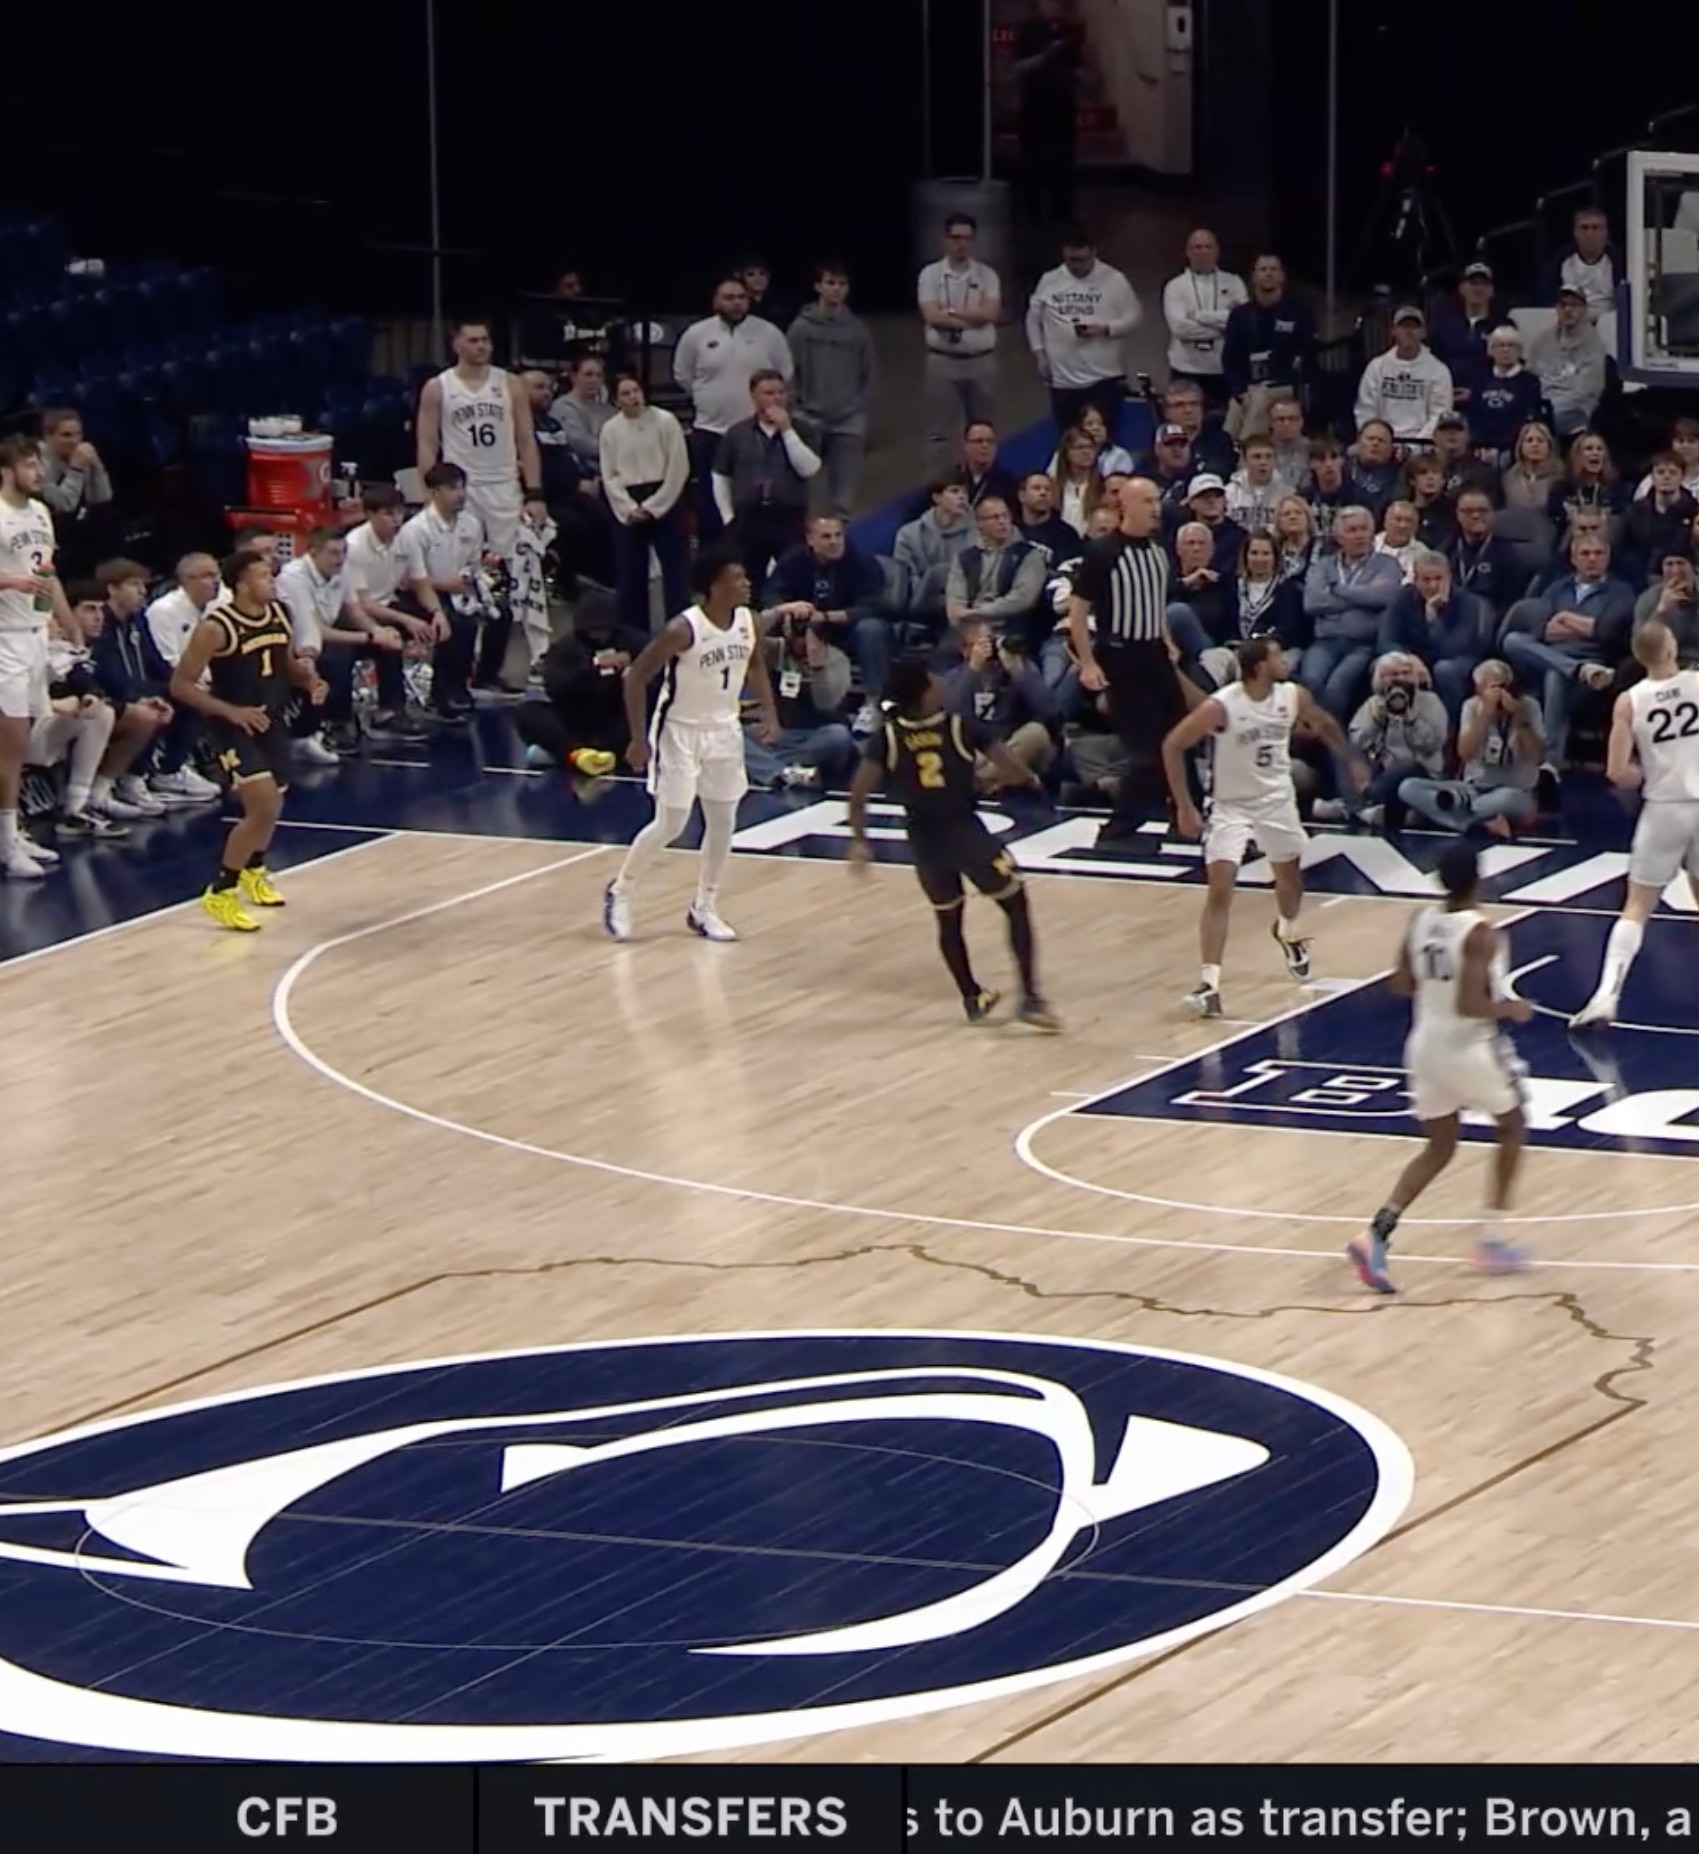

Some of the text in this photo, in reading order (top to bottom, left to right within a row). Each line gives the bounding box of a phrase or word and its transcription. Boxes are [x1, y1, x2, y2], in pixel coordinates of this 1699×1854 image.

[467, 423, 497, 448] 16
[261, 648, 273, 677] 1
[699, 646, 726, 670] PENN
[719, 666, 730, 690] 1
[1255, 744, 1273, 767] 5
[915, 751, 946, 788] 2
